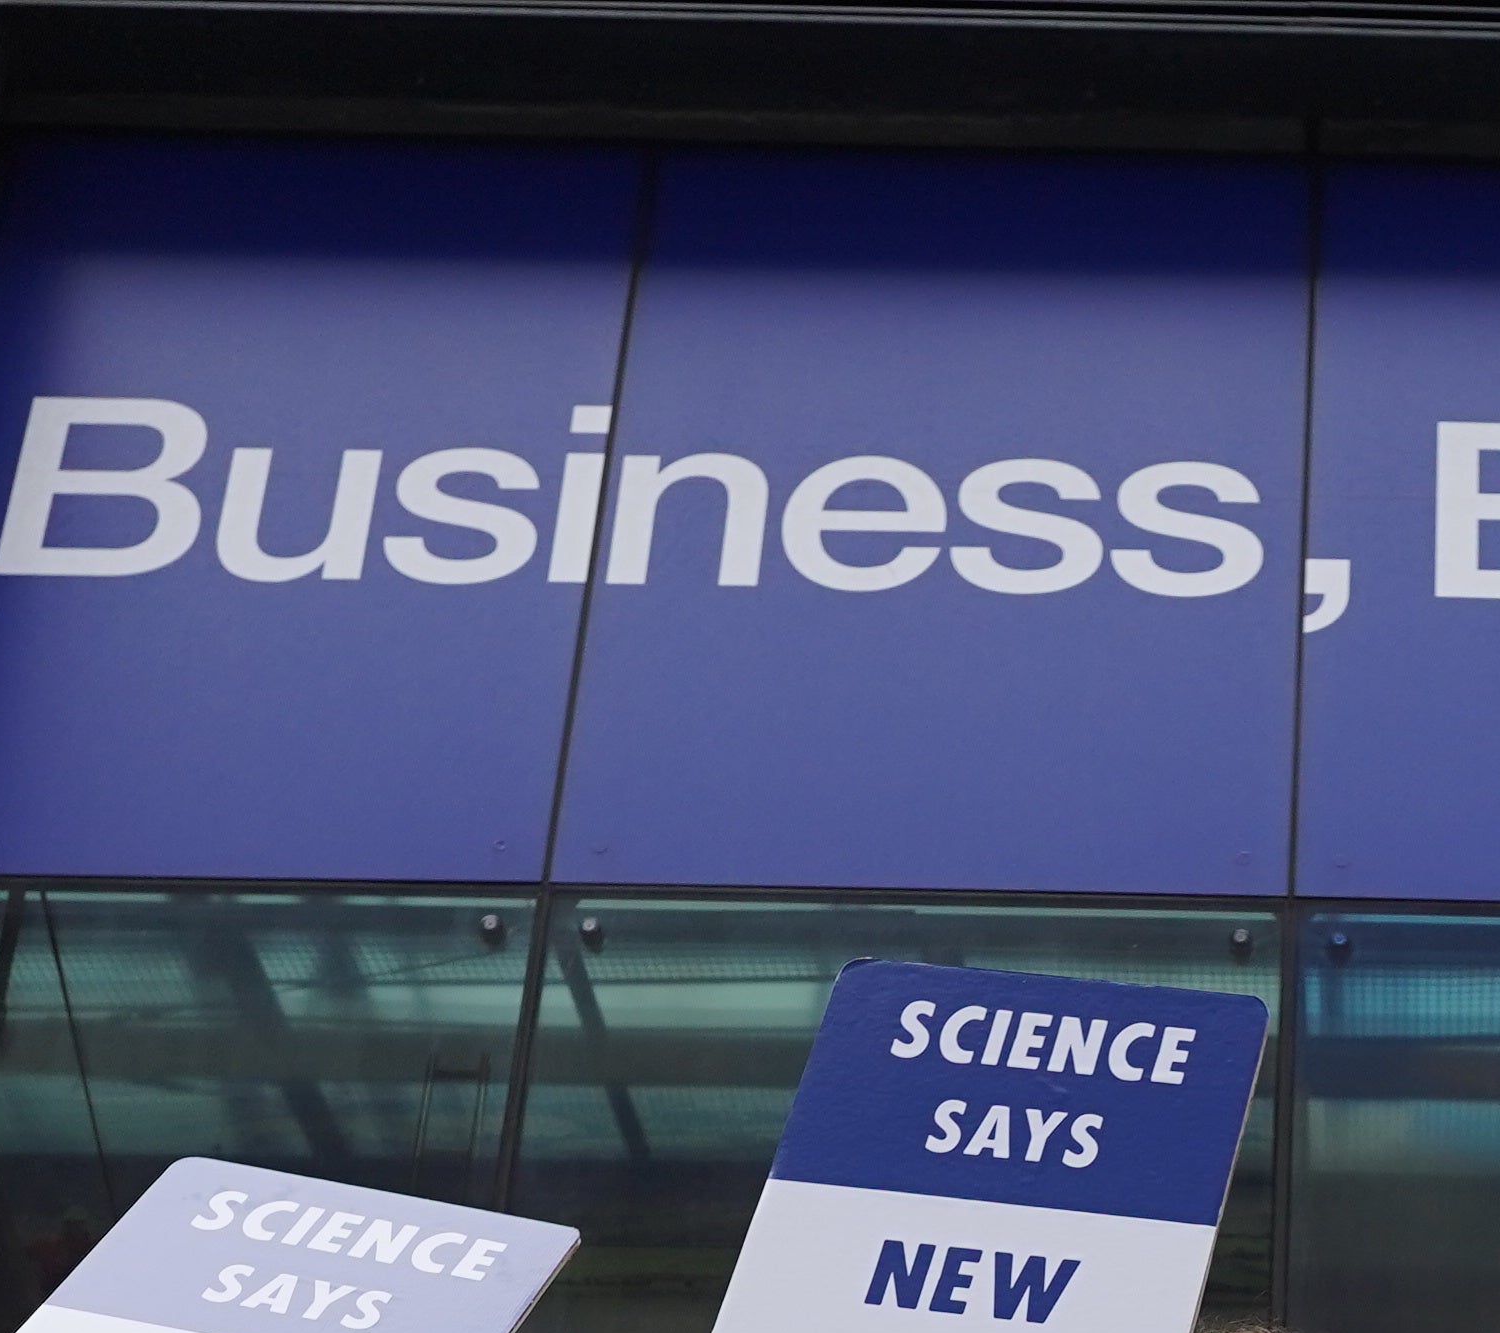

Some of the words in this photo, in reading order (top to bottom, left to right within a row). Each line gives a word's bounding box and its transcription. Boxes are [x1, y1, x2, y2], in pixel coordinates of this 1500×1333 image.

[891, 999, 1197, 1086] SCIENCE
[925, 1098, 1104, 1170] SAYS
[190, 1188, 509, 1283] SCIENCE
[201, 1262, 392, 1332] SAYS
[864, 1238, 1081, 1325] NEW
